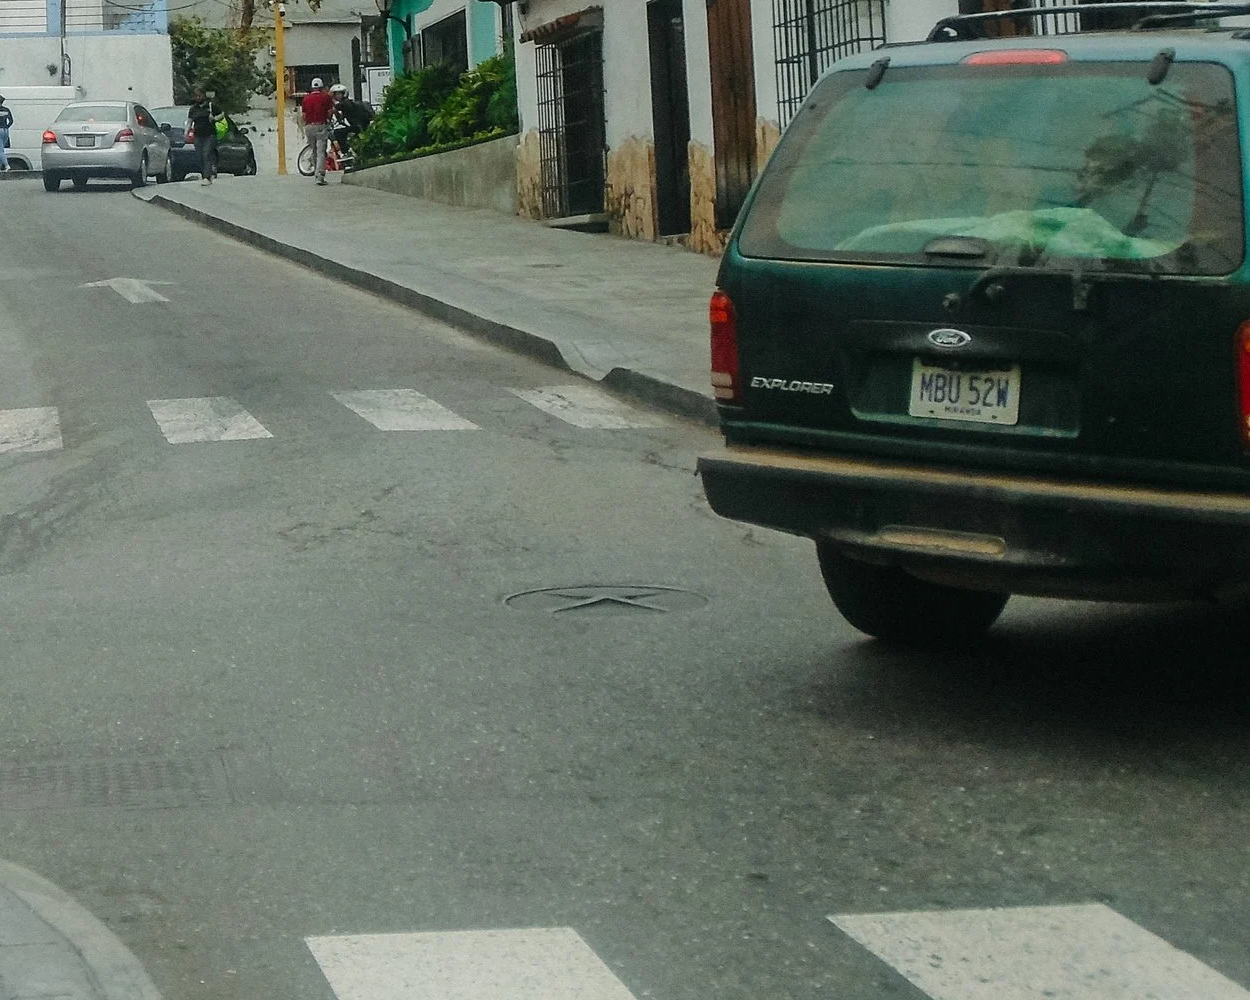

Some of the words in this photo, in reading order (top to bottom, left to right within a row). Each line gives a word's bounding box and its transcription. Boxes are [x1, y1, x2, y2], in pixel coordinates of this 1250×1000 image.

[932, 330, 967, 345] Ford
[750, 376, 835, 396] EXPLORER
[920, 373, 961, 405] MBU
[968, 375, 1010, 408] 52W
